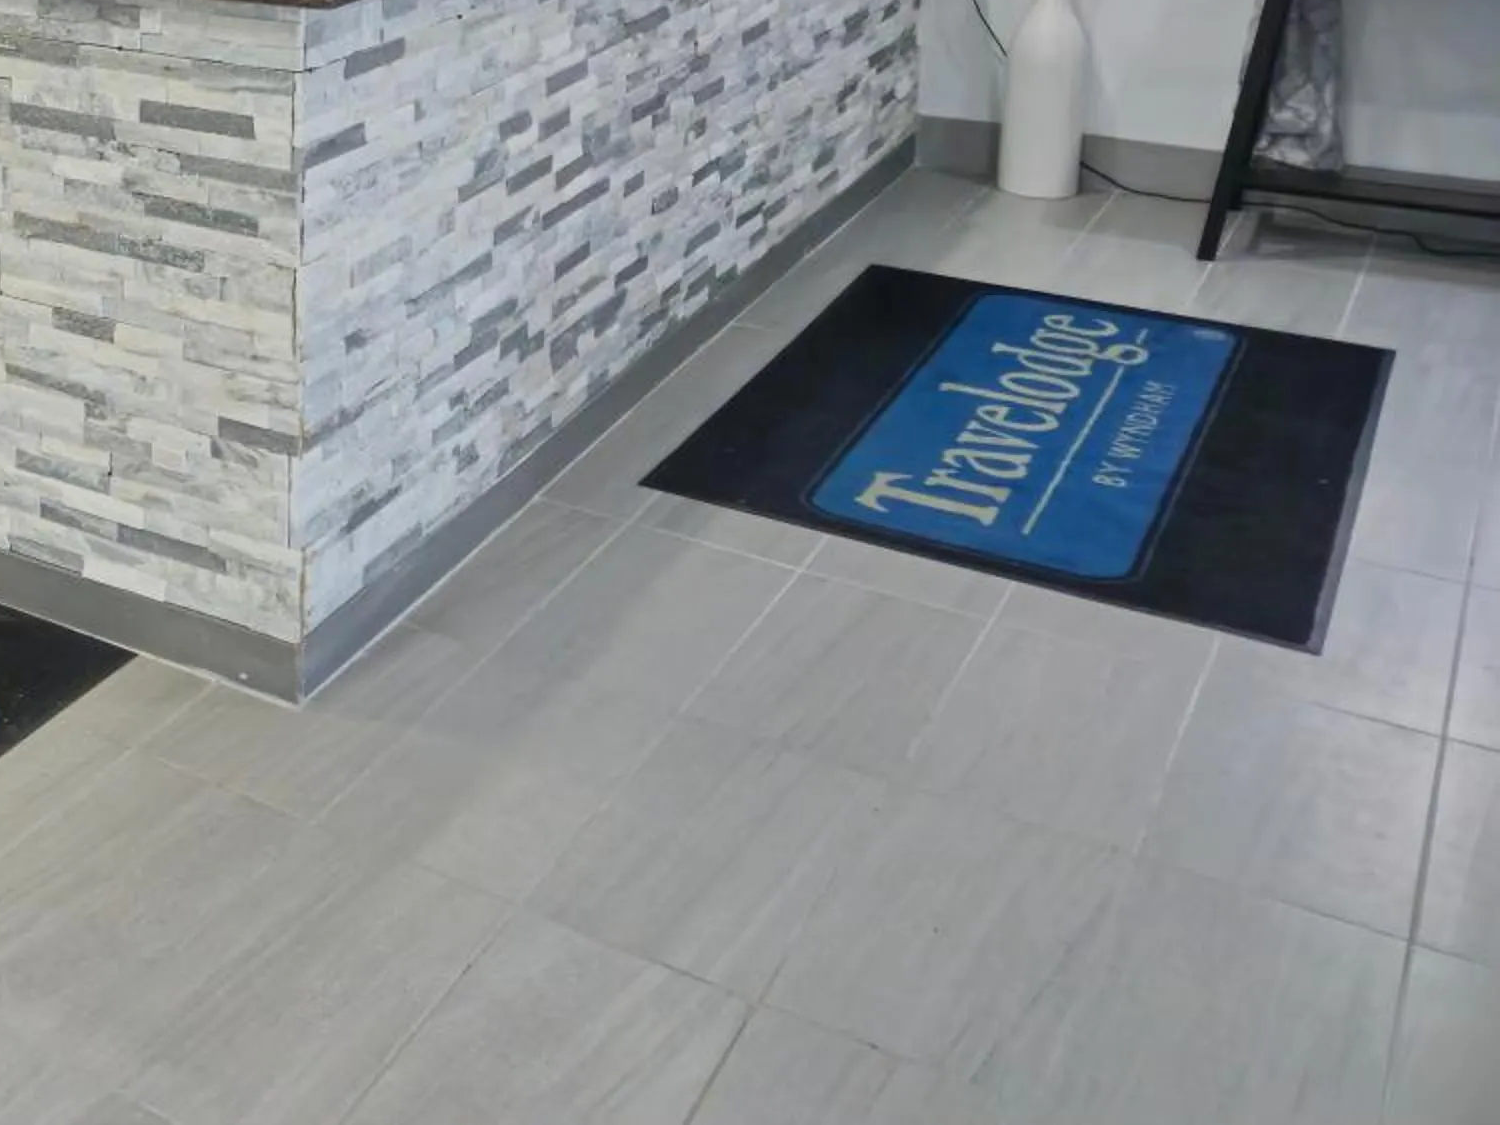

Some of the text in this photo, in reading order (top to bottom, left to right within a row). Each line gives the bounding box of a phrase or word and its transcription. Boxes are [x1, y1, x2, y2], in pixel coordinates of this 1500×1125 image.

[855, 314, 1148, 526] Travelodge
[1092, 380, 1178, 488] BY WYNDHAM
